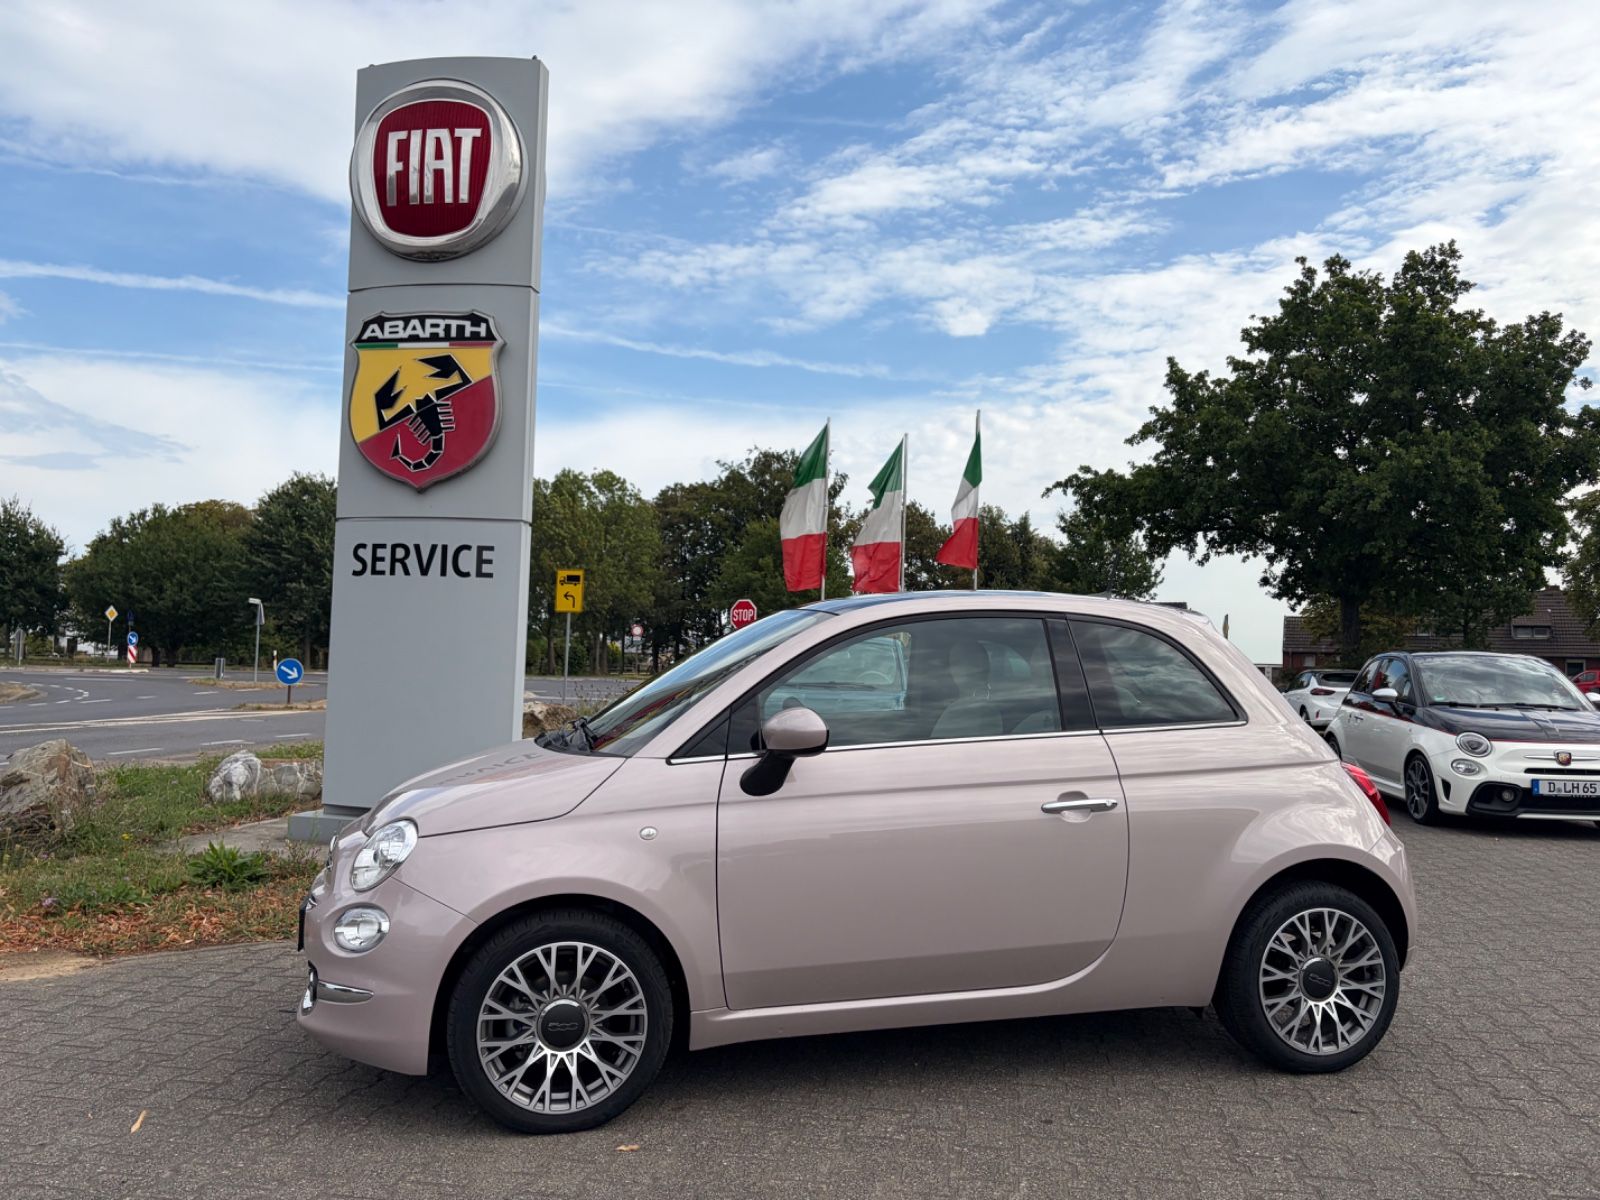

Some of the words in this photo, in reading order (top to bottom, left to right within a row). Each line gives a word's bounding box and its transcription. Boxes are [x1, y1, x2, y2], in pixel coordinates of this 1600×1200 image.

[386, 128, 482, 207] FIAT
[361, 318, 487, 340] ABARTH
[352, 542, 495, 579] SERVICE
[733, 608, 754, 622] STOP
